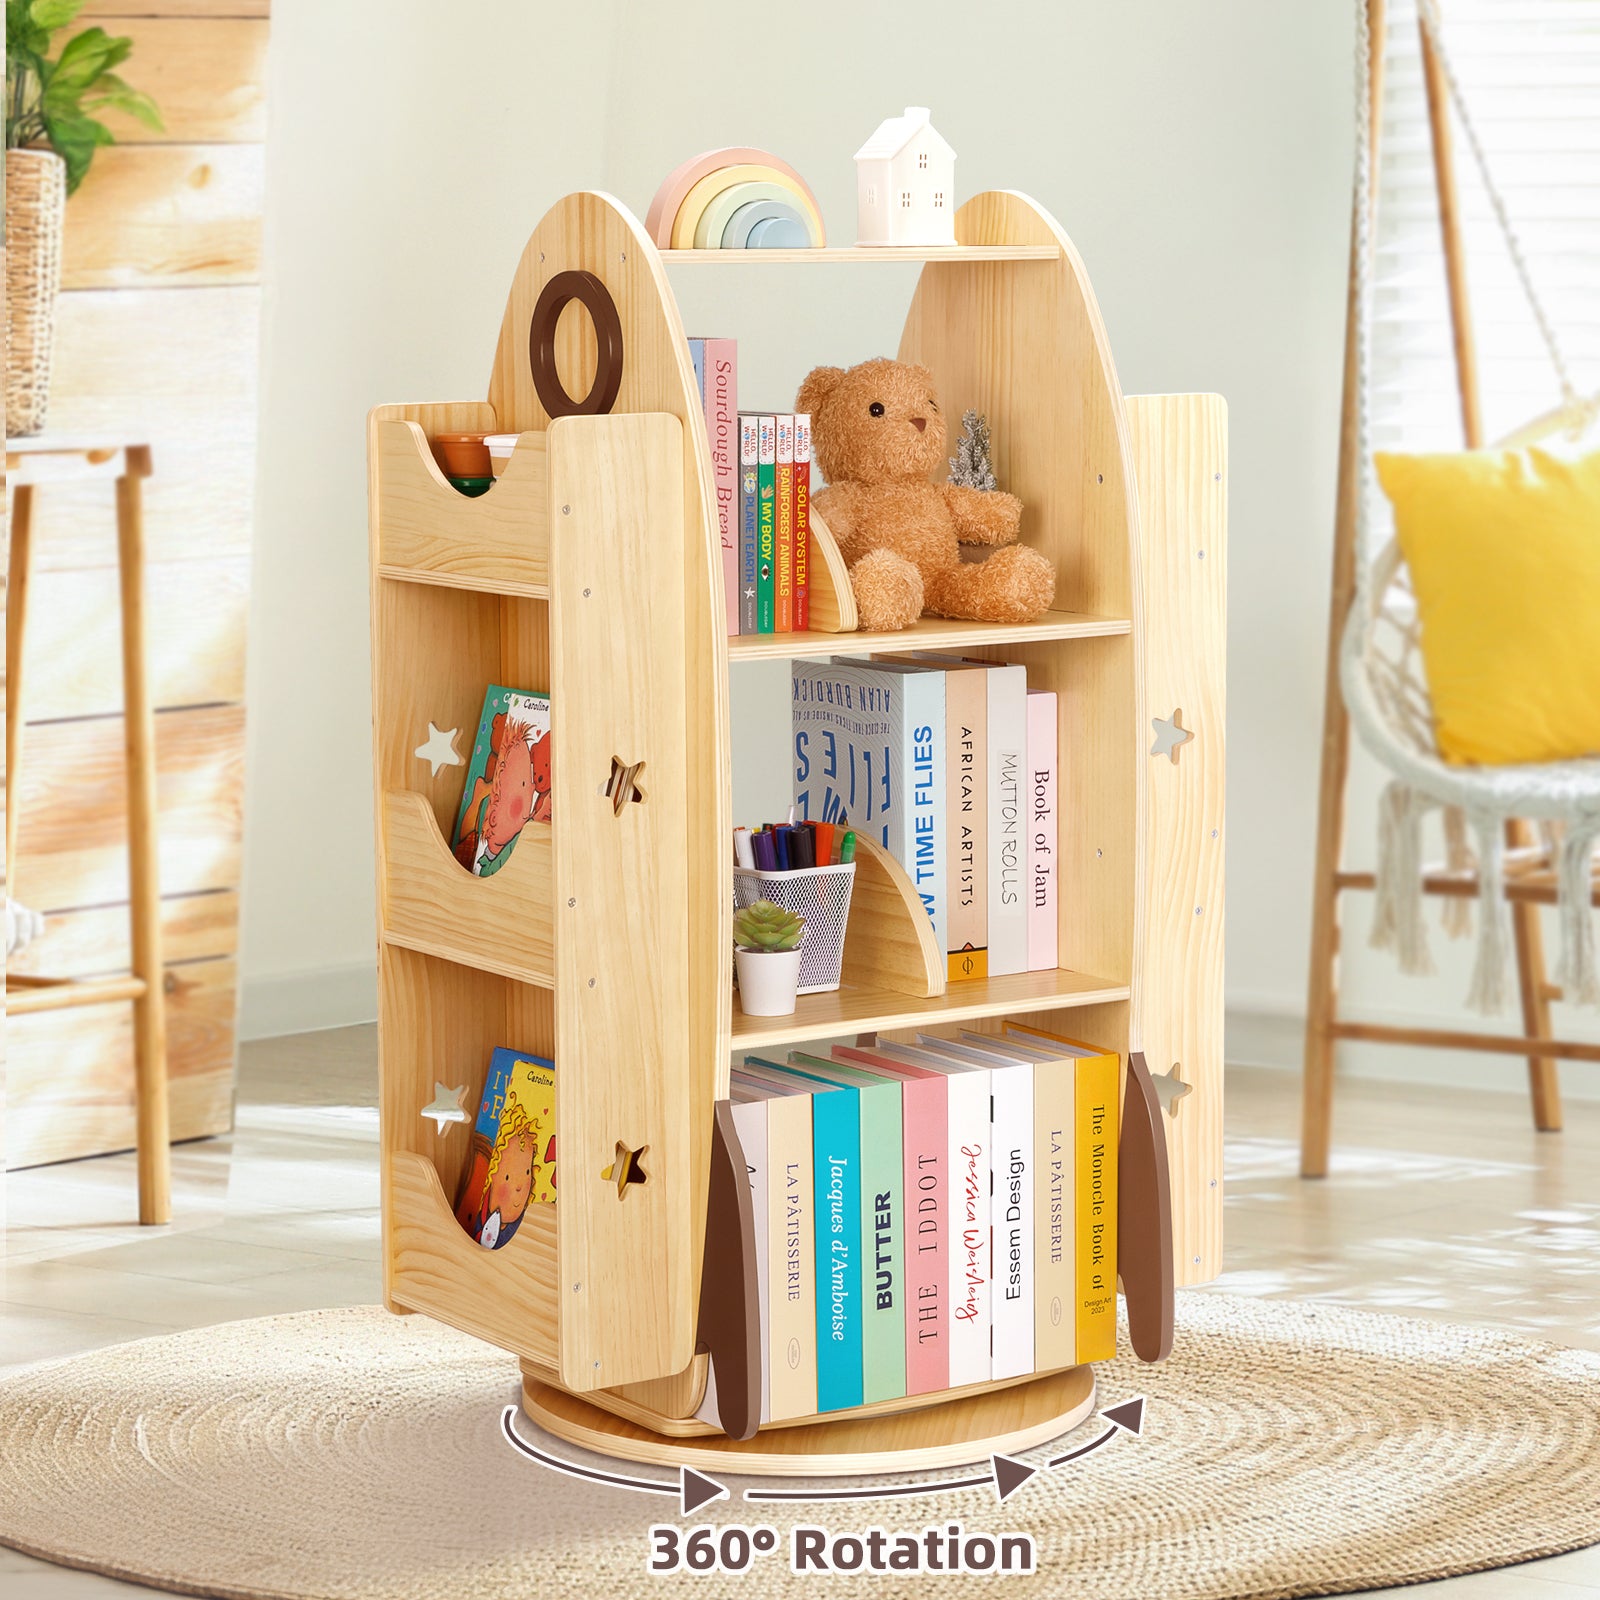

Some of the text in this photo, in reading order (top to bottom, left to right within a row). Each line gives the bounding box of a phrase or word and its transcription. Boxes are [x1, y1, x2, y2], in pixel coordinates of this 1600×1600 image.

[712, 360, 733, 549] Sourdough Bread
[745, 496, 755, 582] PLANET EARTH
[761, 502, 772, 560] MY BODY
[779, 467, 790, 597] RAINFOREST ANIMALS
[796, 485, 807, 585] SOLAR SYSTEM
[793, 678, 890, 713] ALAN BURDICK
[812, 710, 833, 722] INSIDE
[880, 722, 890, 734] THE
[796, 730, 890, 813] FLIES
[913, 726, 933, 806] FLIES
[961, 727, 973, 906] AFRICAN ARTISTS
[915, 815, 935, 884] TIME
[1001, 753, 1018, 904] MUTTON ROLLS
[1034, 769, 1050, 908] Book of Jam
[527, 1070, 553, 1086] Caroline
[787, 1164, 802, 1302] LA PÂTISSERIE
[960, 1144, 982, 1222] Jessica
[1006, 1149, 1025, 1300] Essem Design
[1051, 1130, 1064, 1264] LA PÂTISSERIE
[1092, 1104, 1105, 1290] The Monocle Book of
[827, 1155, 849, 1341] Jacques d'Amboise
[875, 1191, 893, 1310] BUTTER
[918, 1155, 938, 1344] THE IDDOT
[1084, 1299, 1103, 1307] Design
